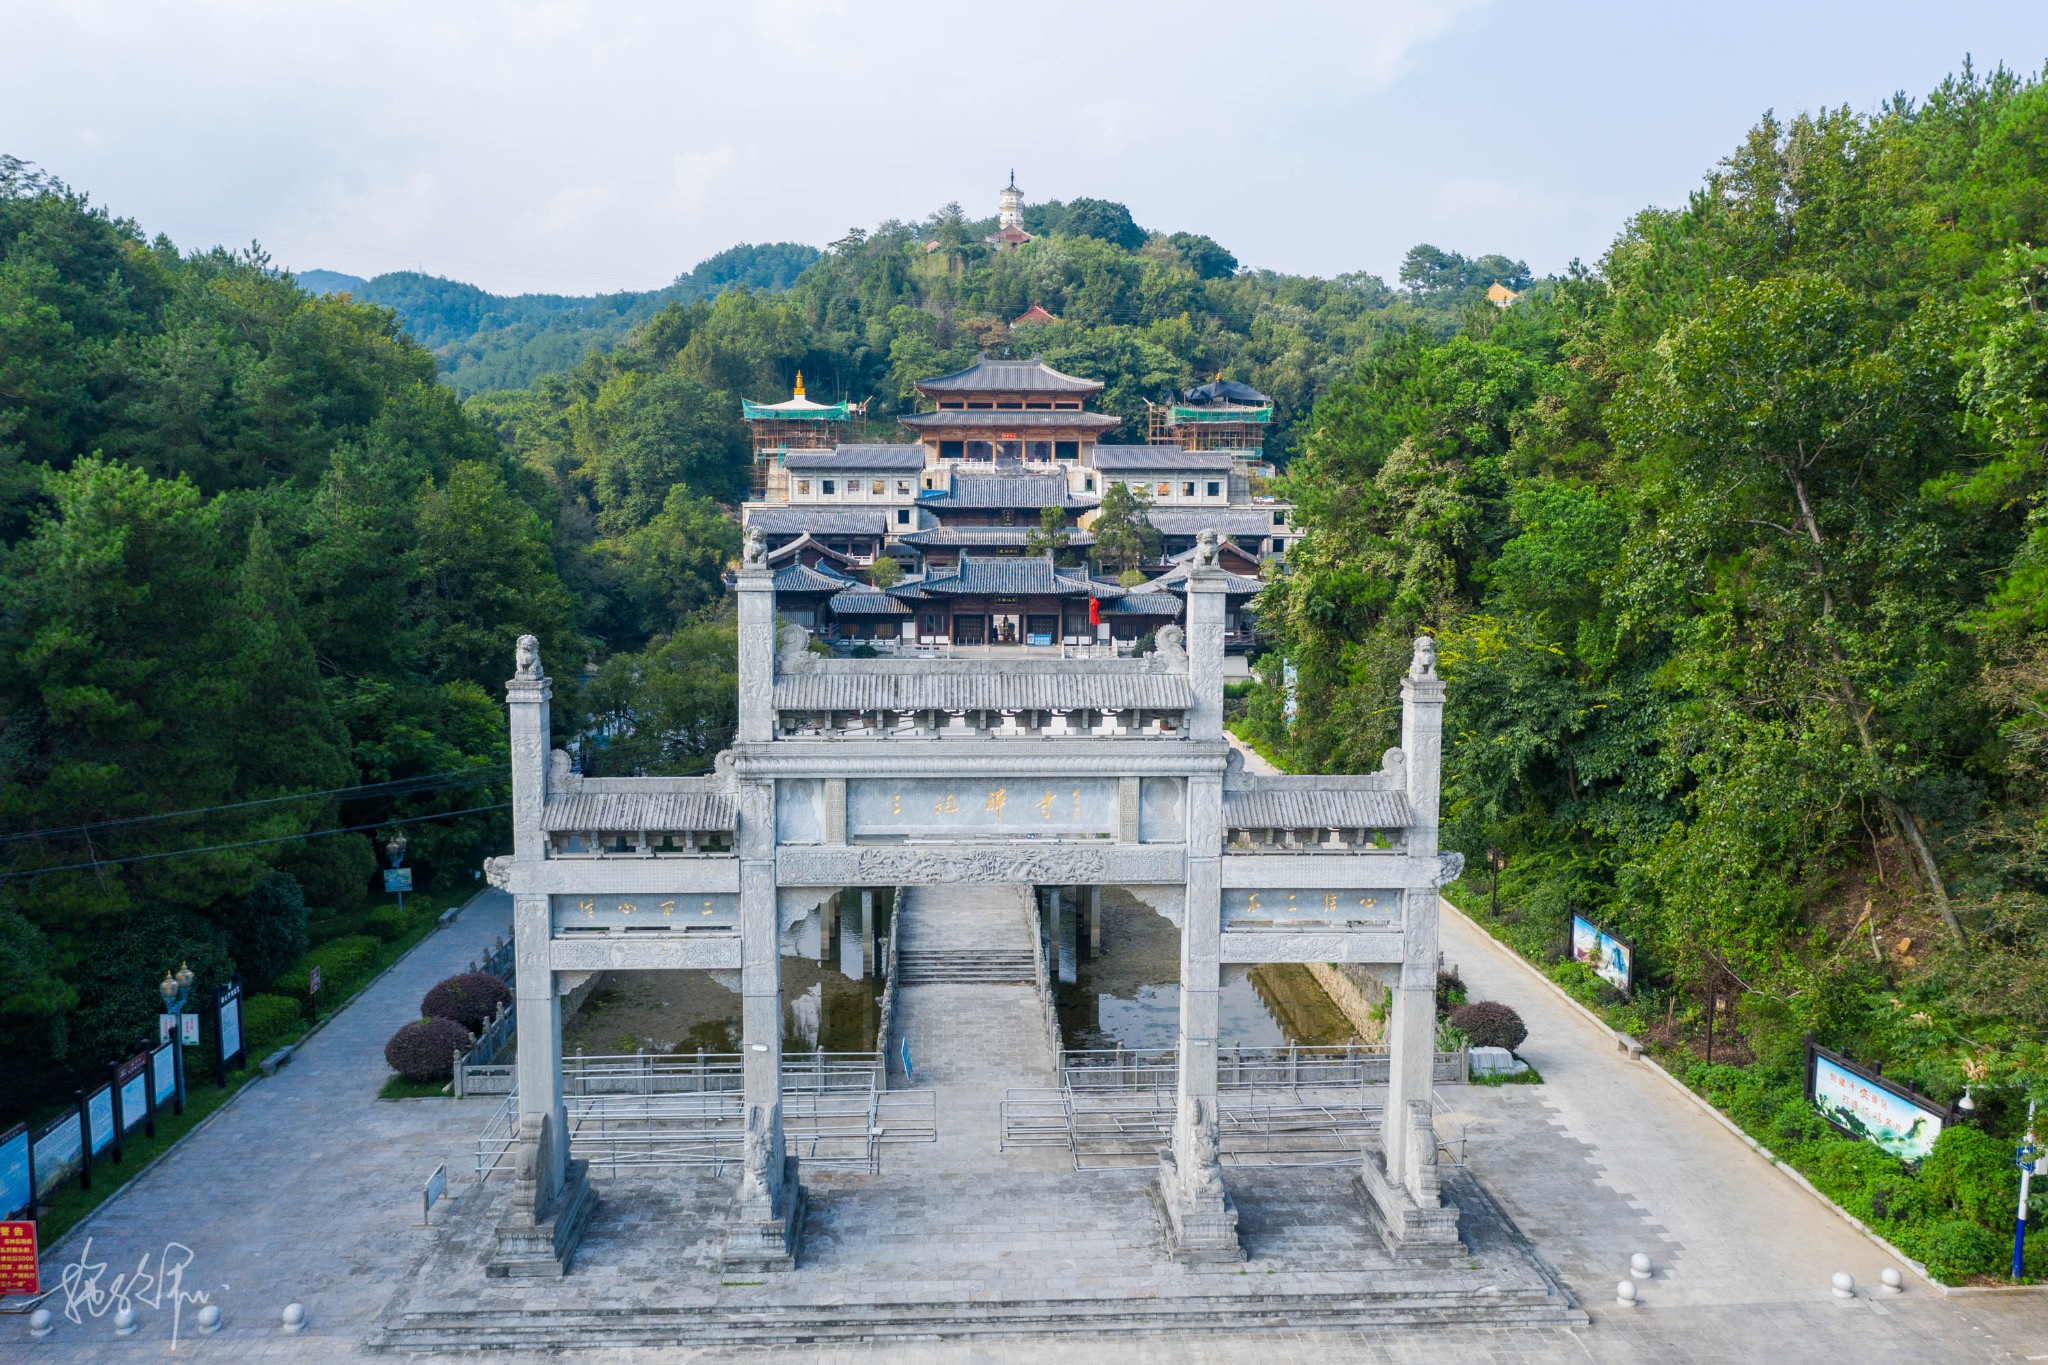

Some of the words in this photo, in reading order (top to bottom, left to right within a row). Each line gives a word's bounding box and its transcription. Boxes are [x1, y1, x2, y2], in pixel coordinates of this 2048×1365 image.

[579, 898, 714, 920] 信心不二
[1247, 892, 1377, 913] 不二信心
[0, 1227, 23, 1236] 警告
